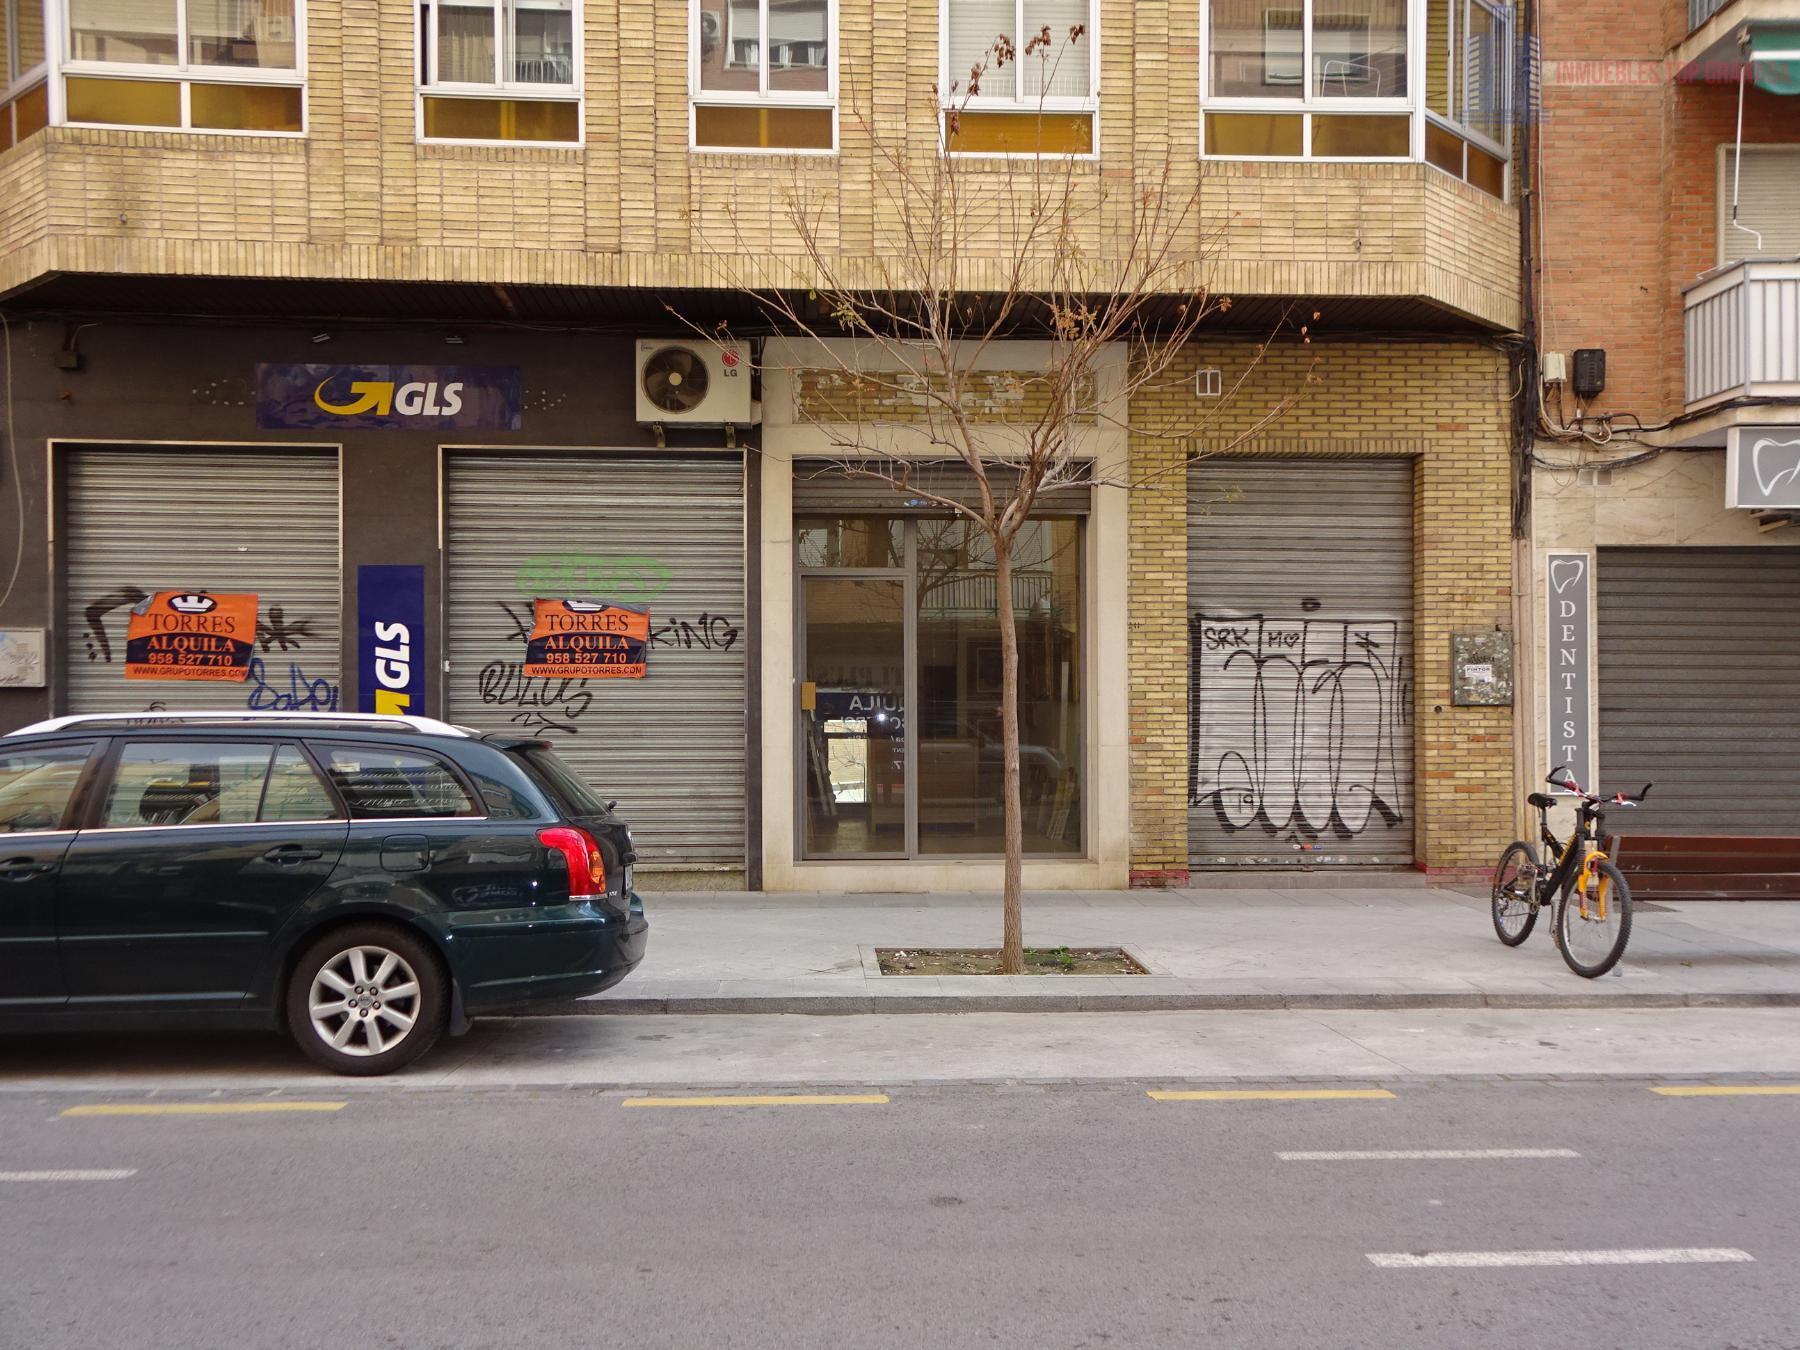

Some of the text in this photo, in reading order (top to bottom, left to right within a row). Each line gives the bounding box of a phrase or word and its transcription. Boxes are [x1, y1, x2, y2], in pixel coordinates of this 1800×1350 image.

[723, 369, 738, 377] LG
[395, 382, 464, 416] GLS
[149, 613, 236, 633] TORRES
[545, 614, 629, 632] TORRES
[147, 635, 236, 653] ALQUILA
[544, 635, 629, 652] ALQUILA
[148, 652, 233, 666] 958 527 710
[375, 621, 410, 689] GLS
[546, 653, 627, 664] 958 527 710
[531, 666, 642, 675] WWW.GRUPOTORRES.COM
[1559, 600, 1577, 783] DENTISTA
